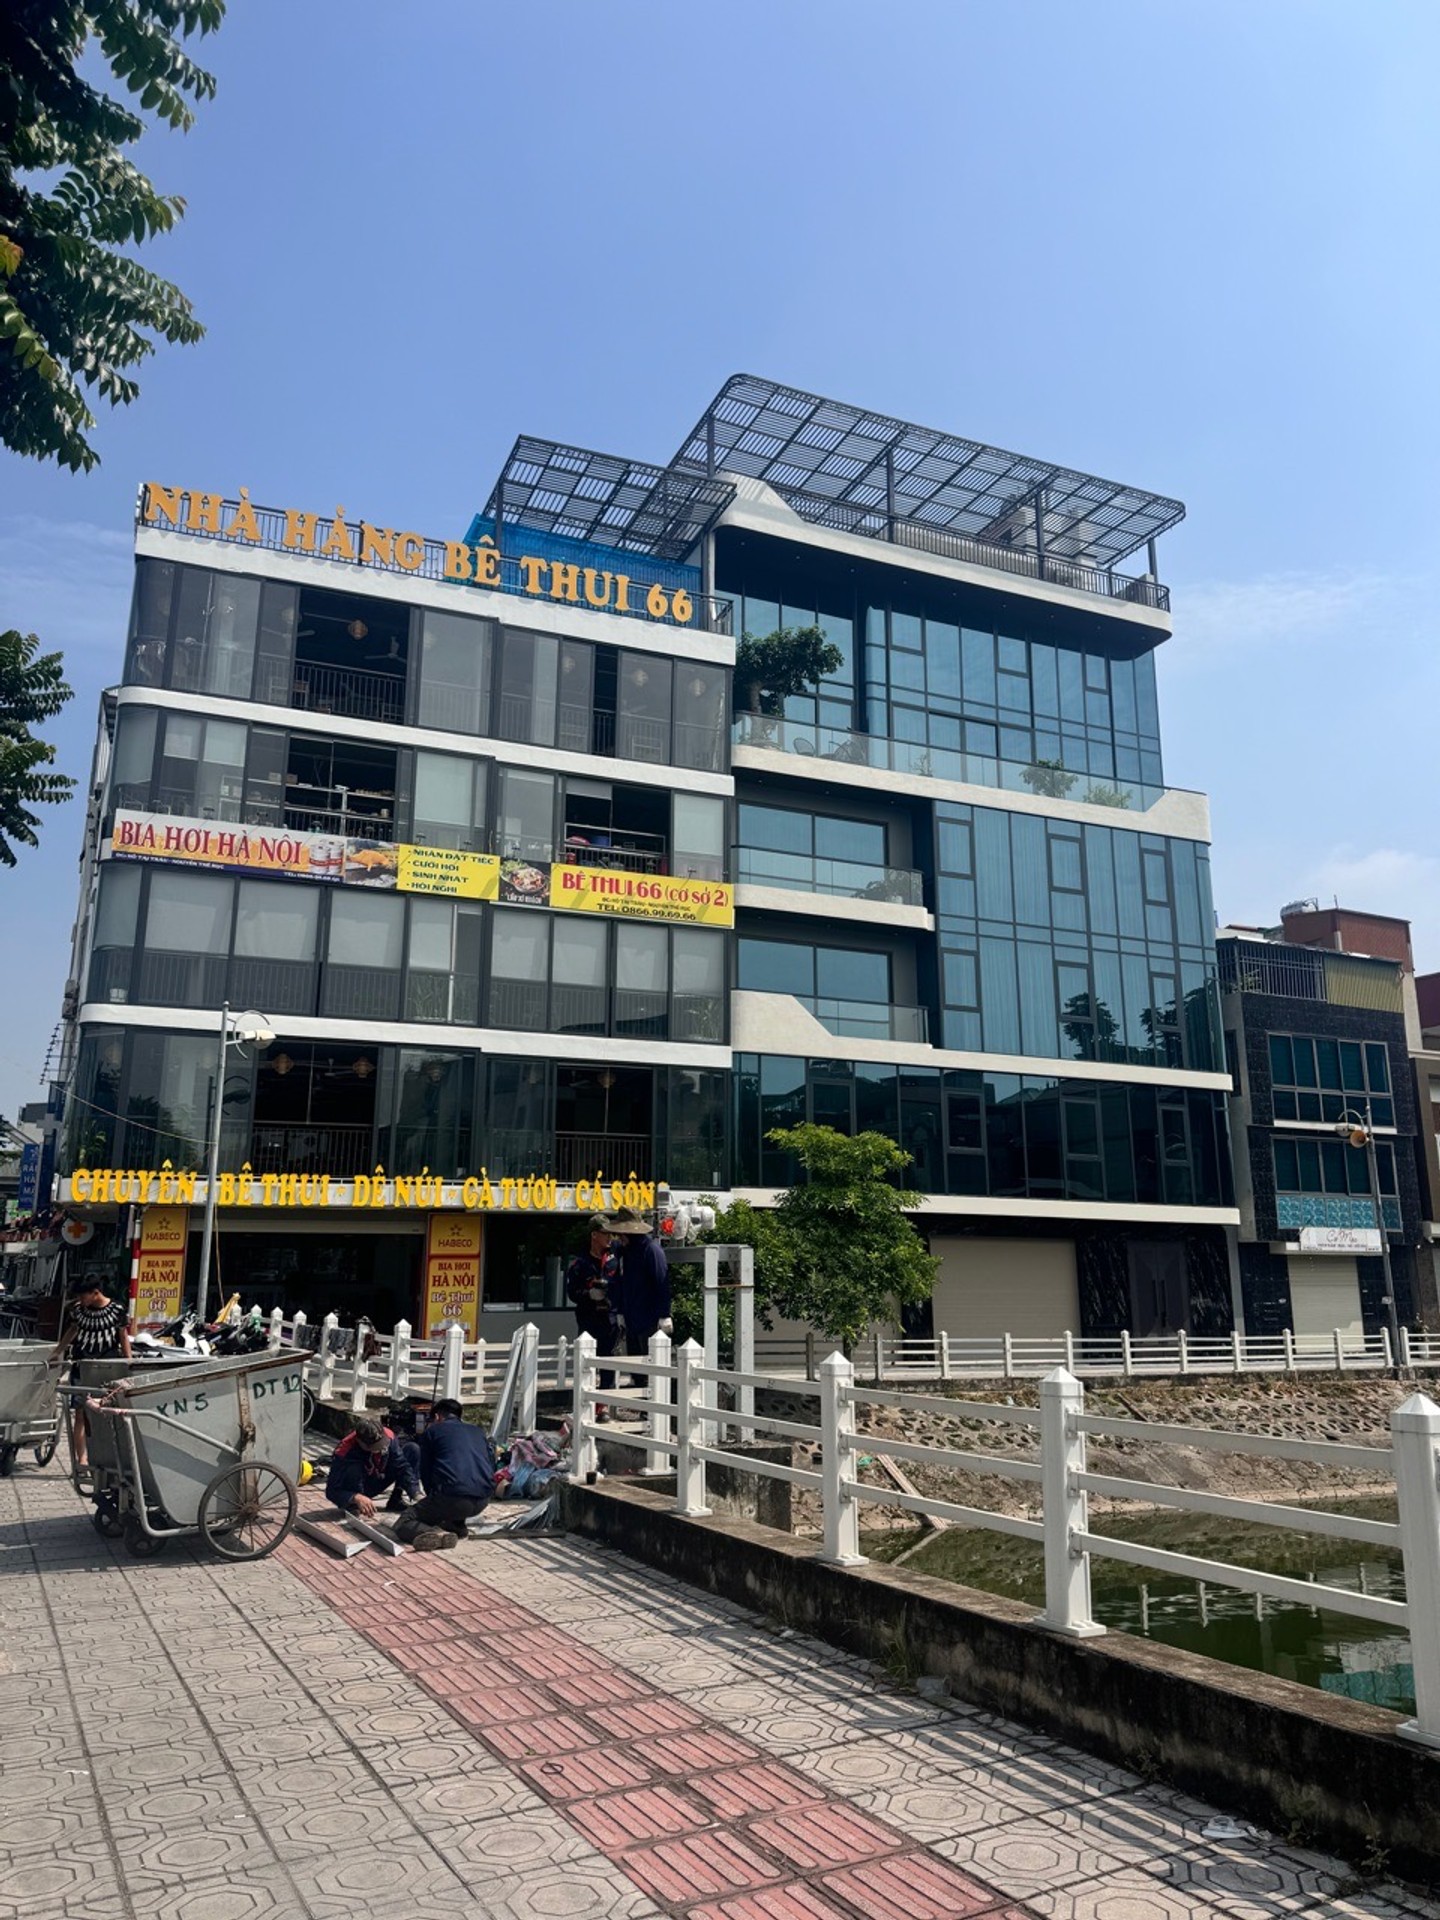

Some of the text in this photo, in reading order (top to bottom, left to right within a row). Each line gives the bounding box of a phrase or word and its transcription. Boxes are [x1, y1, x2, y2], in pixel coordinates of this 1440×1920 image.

[144, 482, 693, 623] NHÀ HÀNG BÊ THUI 66
[120, 820, 302, 867] BIA HƠI HÀ NỘI
[412, 870, 437, 880] SINH
[562, 869, 586, 891] BÊ
[590, 874, 632, 897] THUI
[636, 881, 662, 900] 66
[714, 889, 729, 907] 2)
[71, 1158, 198, 1205] CHUYÊN
[219, 1161, 252, 1206] BÊ
[262, 1173, 331, 1207] THUI
[352, 1164, 386, 1208] DÊ
[394, 1166, 444, 1208] NÚI
[462, 1167, 495, 1209] GÀ
[500, 1173, 558, 1210] TƯƠI
[576, 1170, 605, 1210] CÁ
[146, 1232, 180, 1240] HABECO
[438, 1238, 472, 1248] HABECO
[438, 1262, 452, 1271] BIA
[142, 1269, 180, 1284] HÀ NỘI
[432, 1272, 476, 1290] HÀ NỘI
[148, 1298, 167, 1312] 66
[442, 1304, 463, 1318] 66
